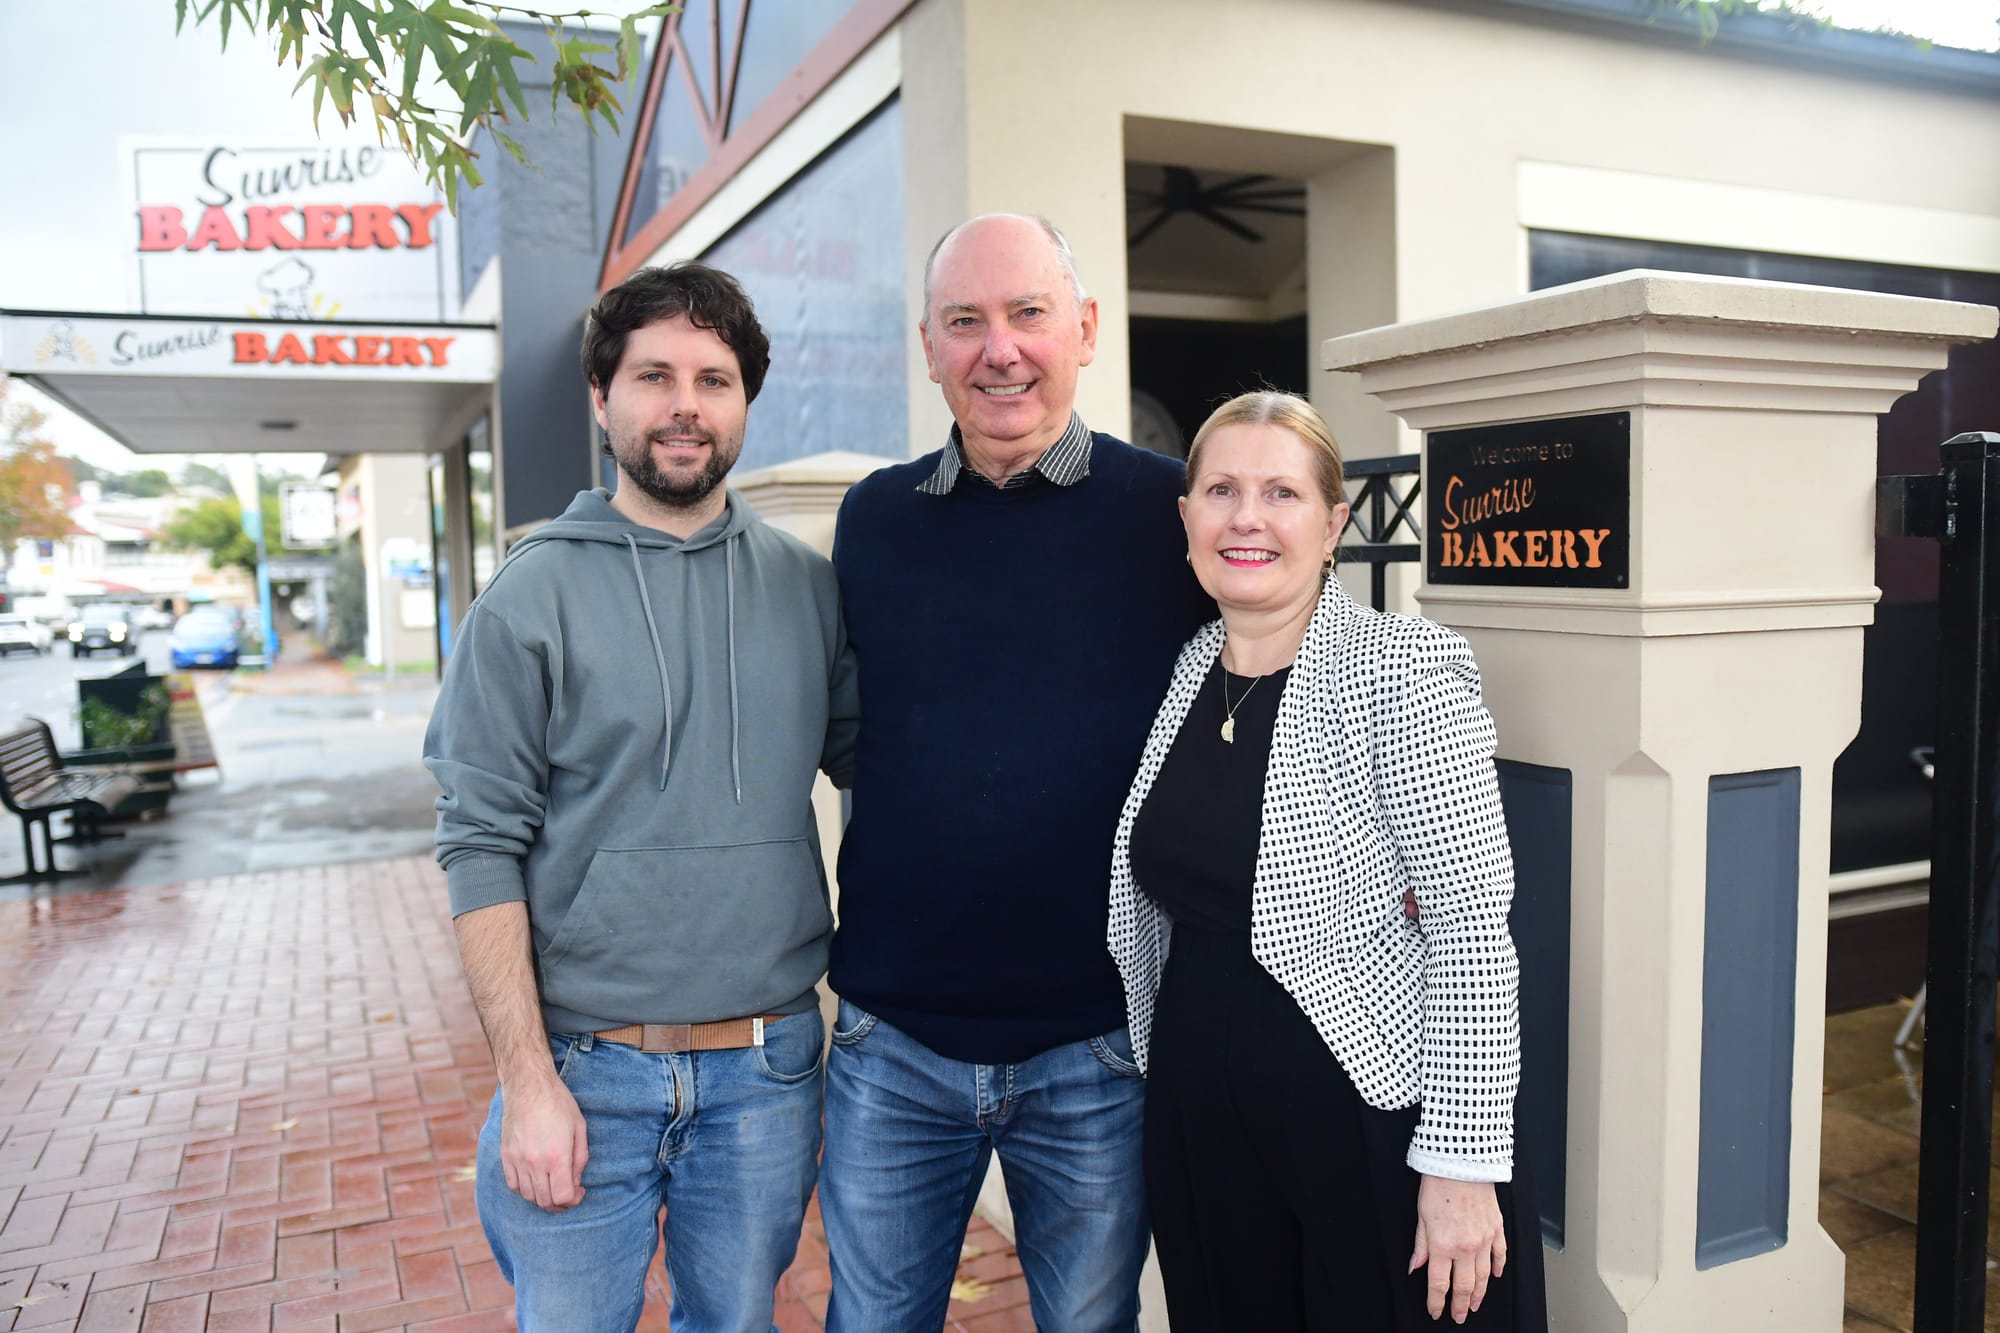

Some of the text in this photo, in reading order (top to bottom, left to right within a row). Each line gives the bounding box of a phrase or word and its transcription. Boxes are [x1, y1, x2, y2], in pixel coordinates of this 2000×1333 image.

[196, 147, 383, 206] Sunrise
[138, 204, 443, 251] BAKERY
[111, 326, 455, 366] Sunrise BAKERY
[1472, 442, 1573, 465] Wecome to
[1441, 475, 1536, 529] Sunrise
[1441, 529, 1610, 568] BAKERY
